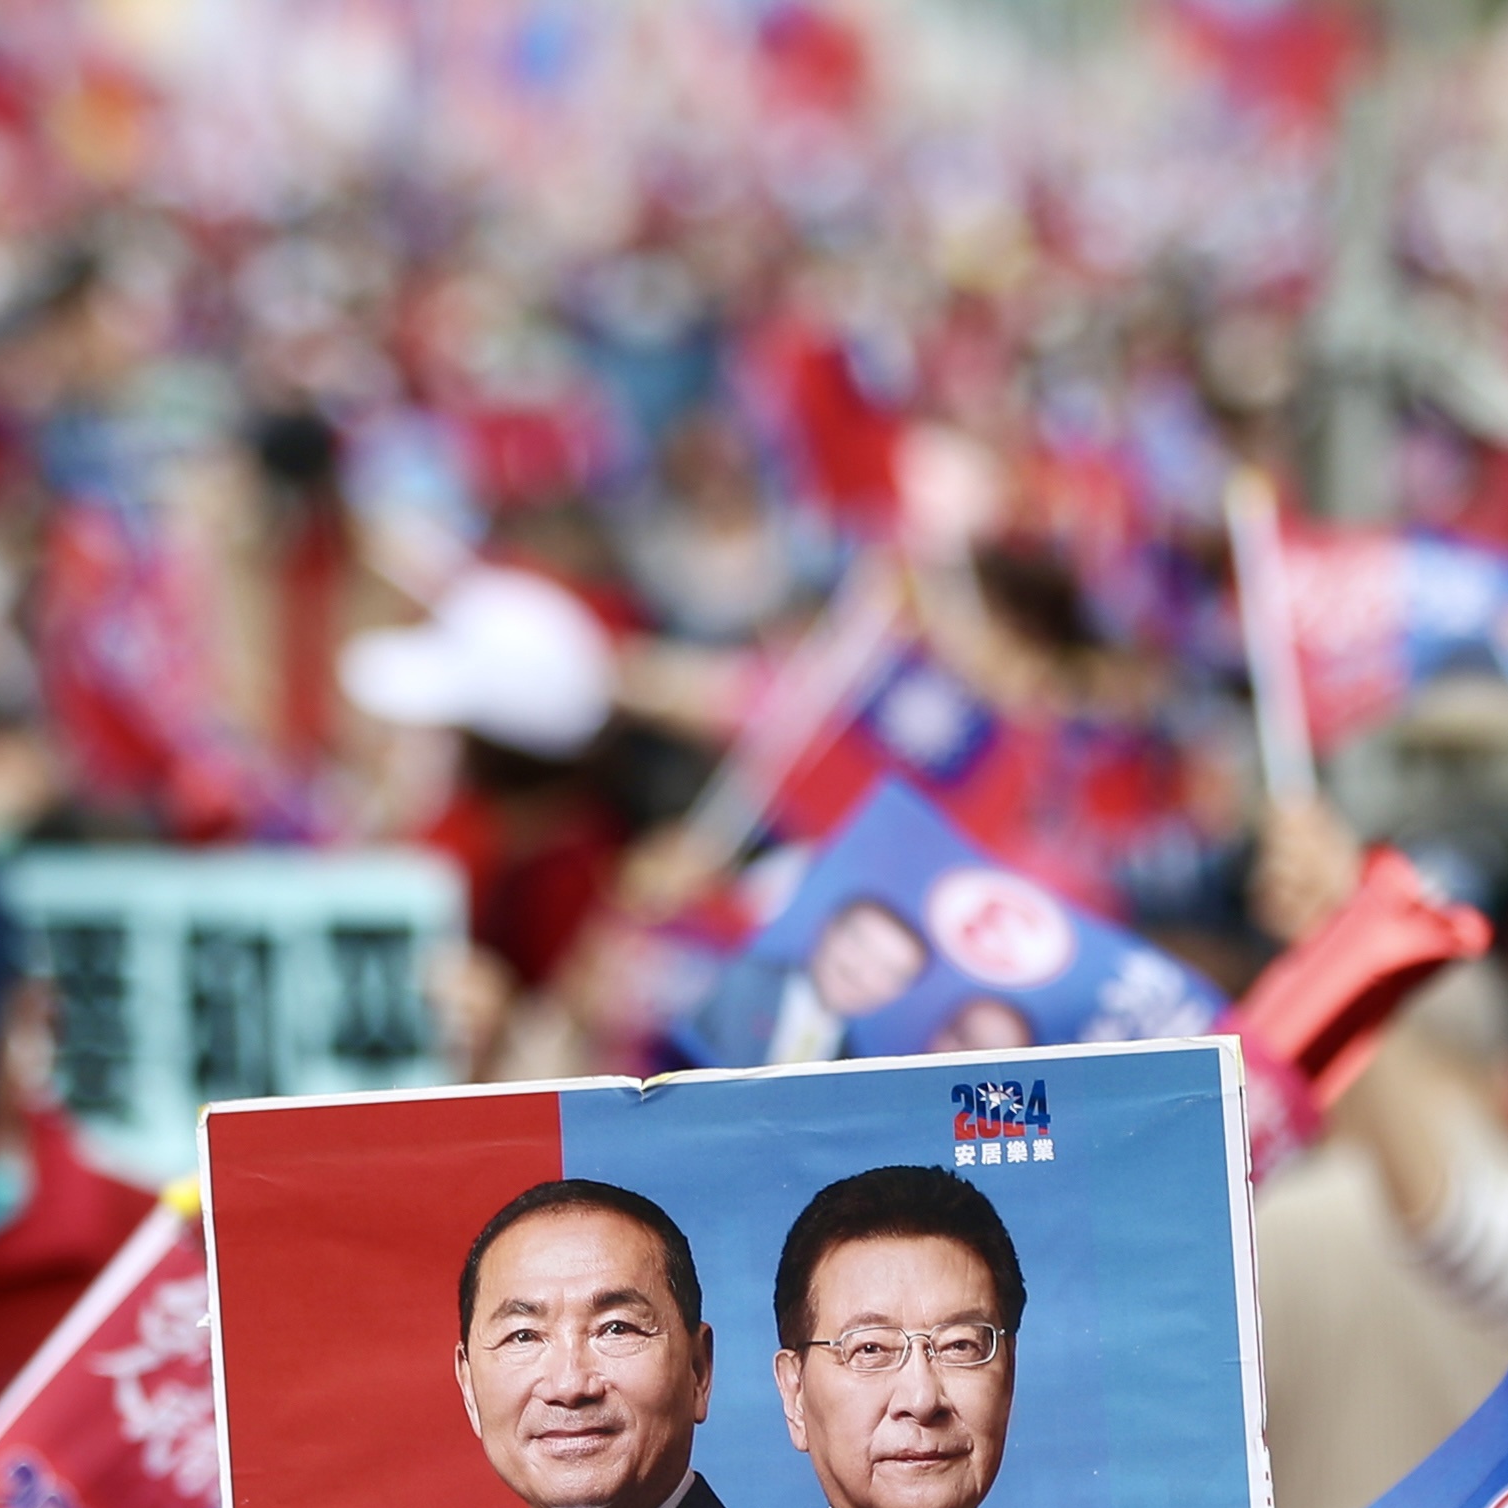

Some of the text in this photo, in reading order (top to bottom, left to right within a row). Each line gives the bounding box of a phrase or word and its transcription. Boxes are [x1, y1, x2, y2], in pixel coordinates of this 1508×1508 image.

[951, 1081, 1051, 1138] 2024
[953, 1139, 1055, 1167] 安居樂業
